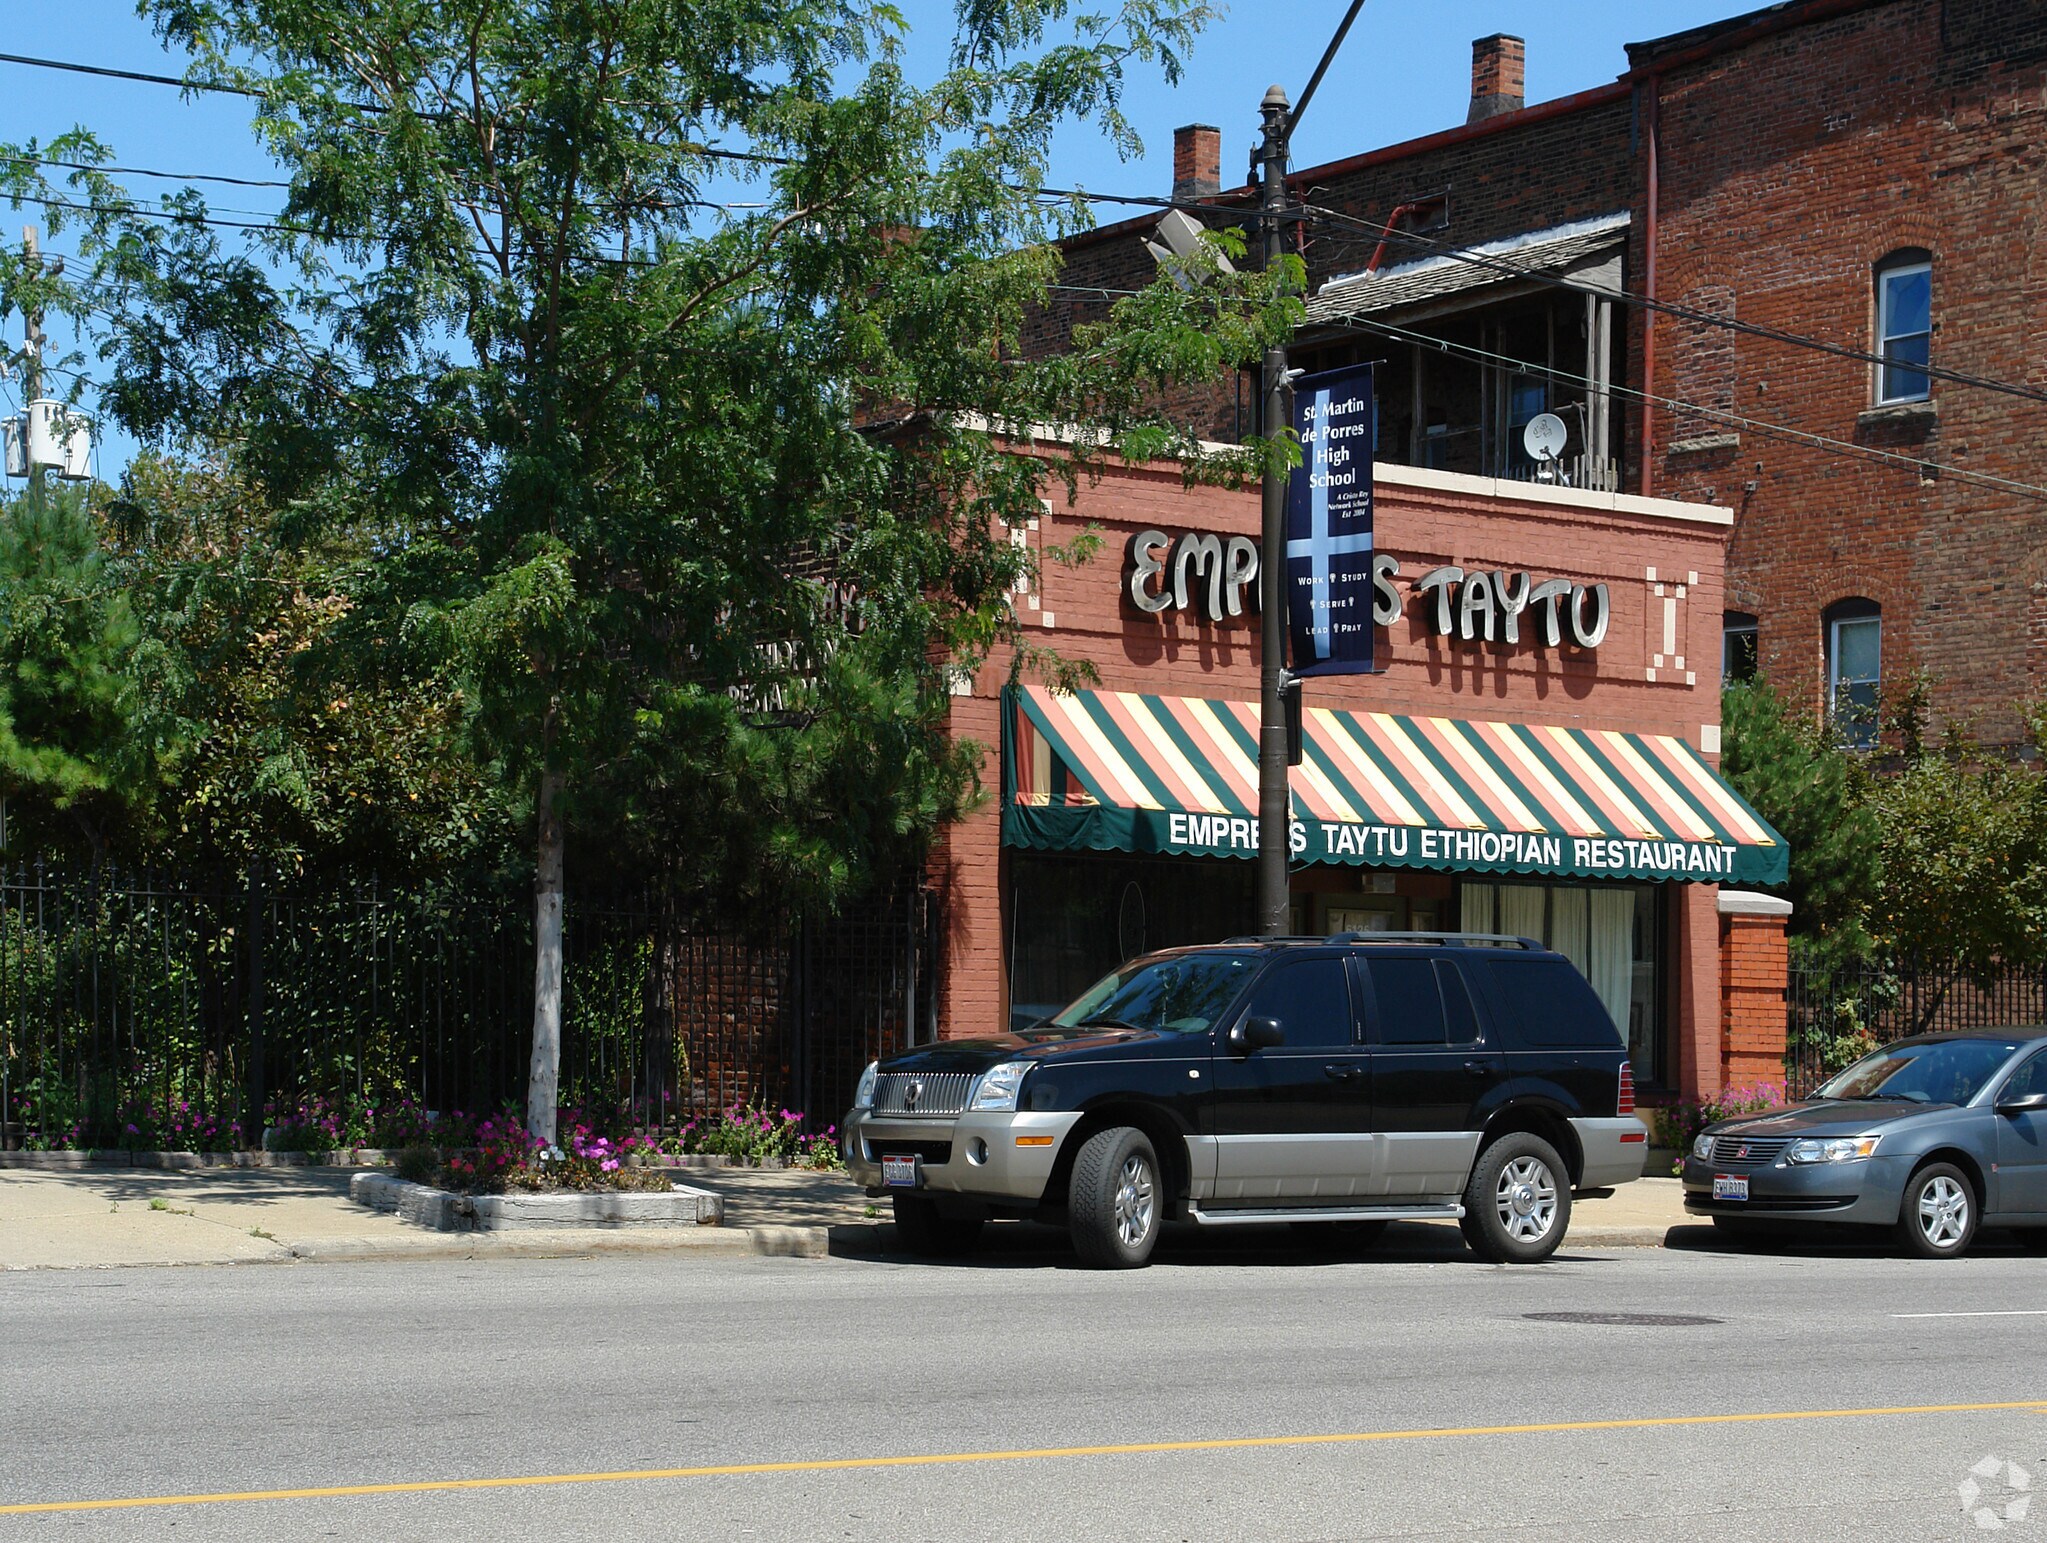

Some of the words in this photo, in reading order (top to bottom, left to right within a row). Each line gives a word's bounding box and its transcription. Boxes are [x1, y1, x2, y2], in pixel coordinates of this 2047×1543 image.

[1303, 405, 1318, 421] St.
[1321, 397, 1365, 417] Martin
[1301, 427, 1318, 443] de
[1322, 423, 1365, 440] Porres
[1316, 445, 1350, 466] High
[1309, 467, 1356, 489] School
[1328, 501, 1351, 510] Network
[1352, 498, 1370, 508] School
[1336, 493, 1342, 501] A
[1128, 529, 1402, 627] EMPS
[1413, 565, 1610, 649] TAYTU
[1297, 576, 1324, 586] WORK
[1341, 572, 1367, 582] STUDY
[1319, 599, 1346, 609] SERVE
[1305, 626, 1329, 635] LEAD
[1341, 623, 1362, 633] PRAY
[1169, 813, 1307, 853] EMPRES
[1321, 823, 1409, 857] TAYTU
[1420, 829, 1561, 867] ETHIOPIAN
[1574, 838, 1737, 874] RESTAURANT
